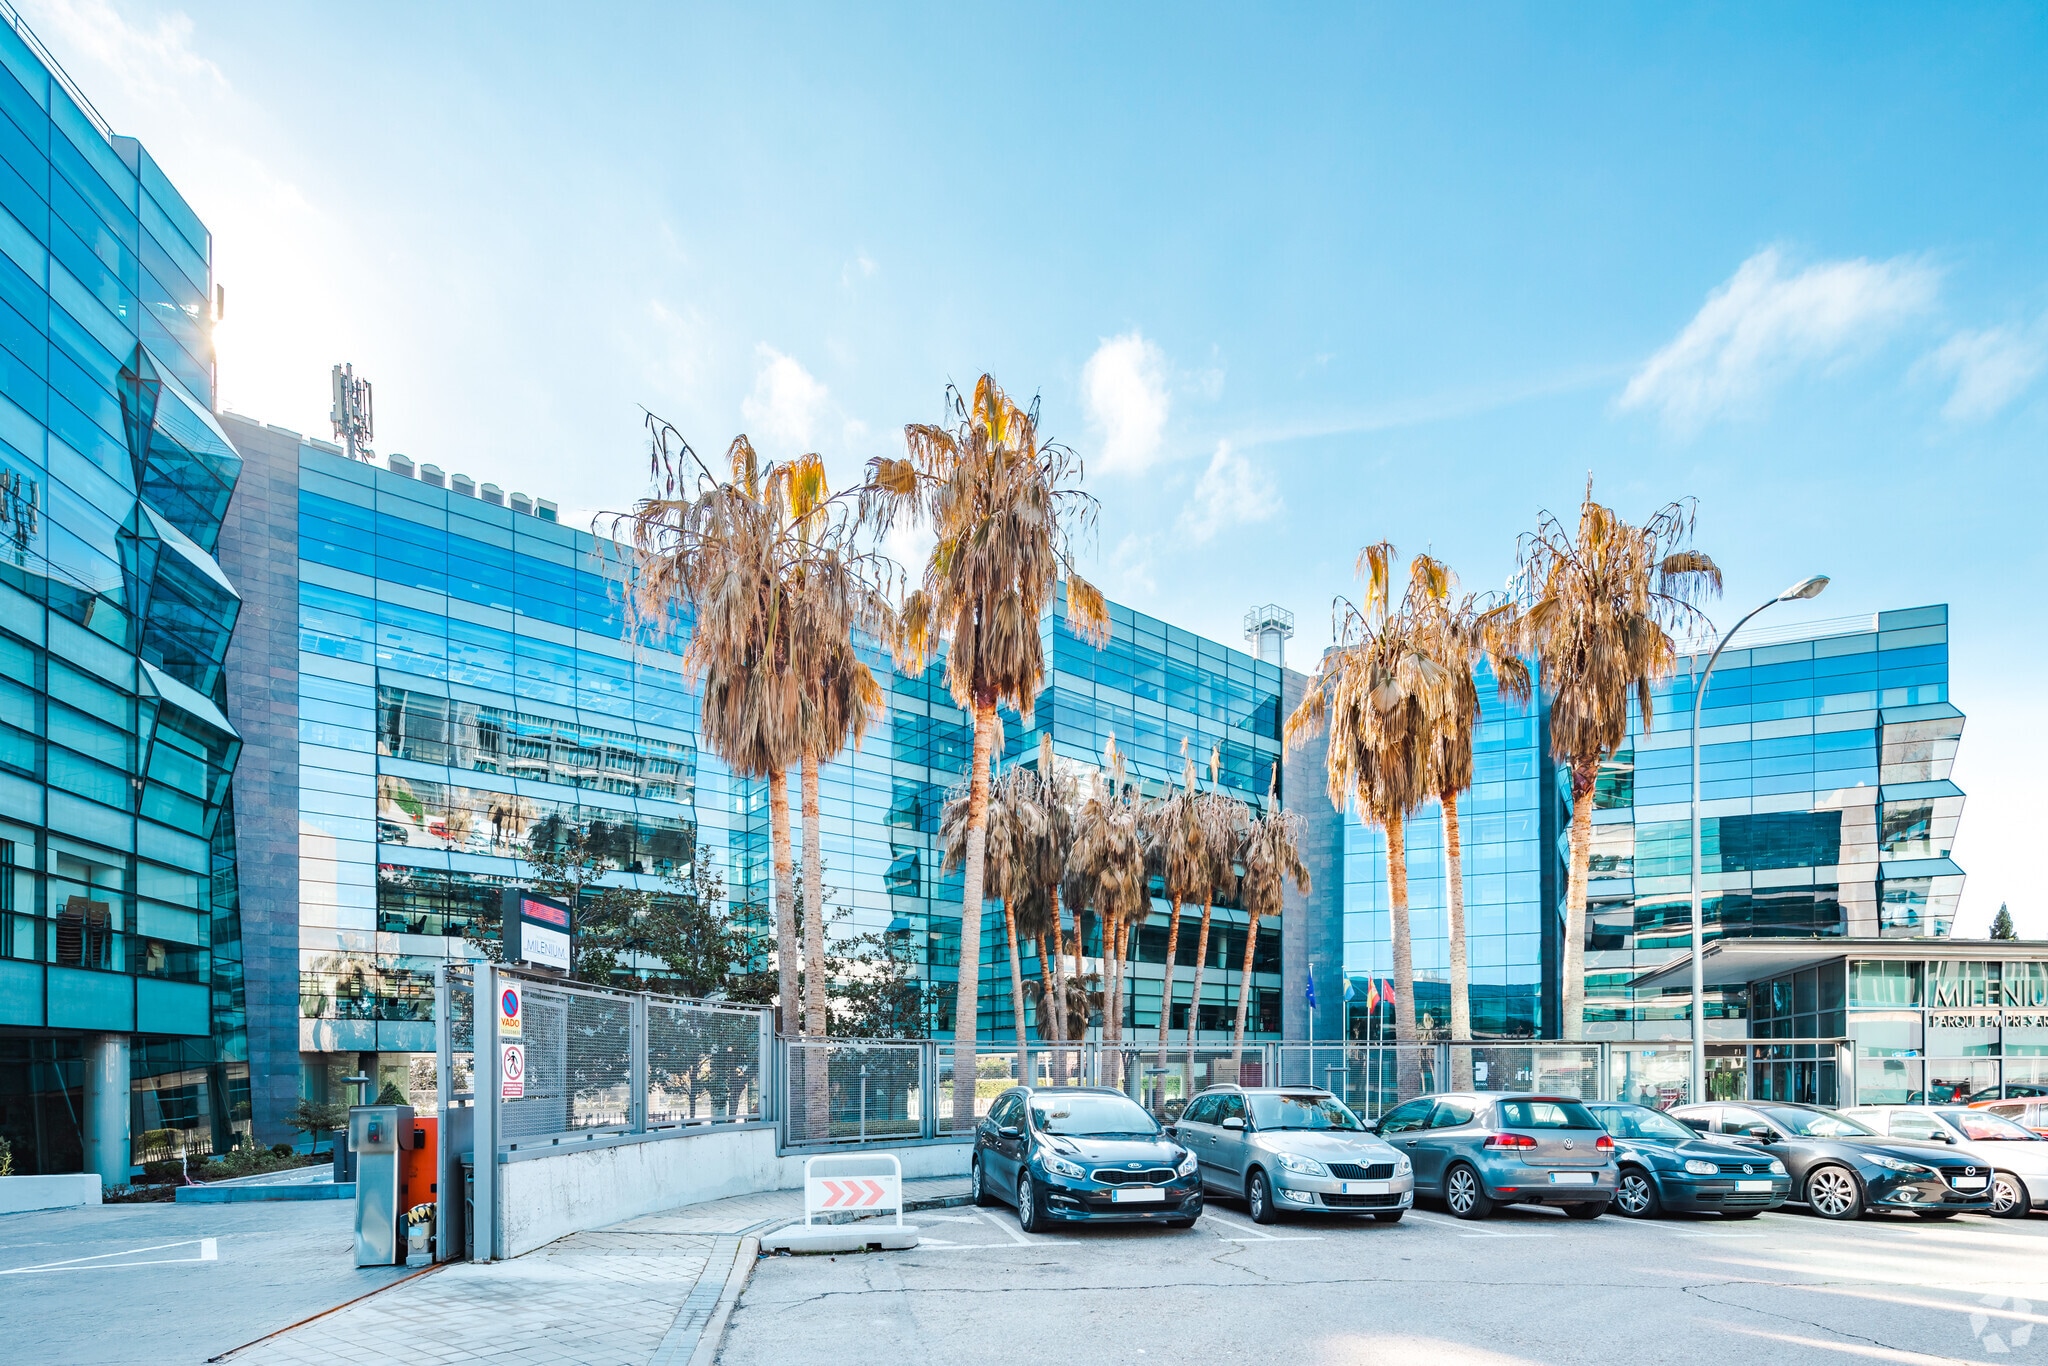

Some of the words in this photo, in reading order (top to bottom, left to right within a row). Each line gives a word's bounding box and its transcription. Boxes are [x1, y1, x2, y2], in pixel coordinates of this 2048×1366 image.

[526, 938, 567, 958] MILENIUM
[1934, 979, 2047, 1007] MILENIU
[501, 1018, 520, 1028] VADO
[1933, 1015, 1981, 1028] PARQUE
